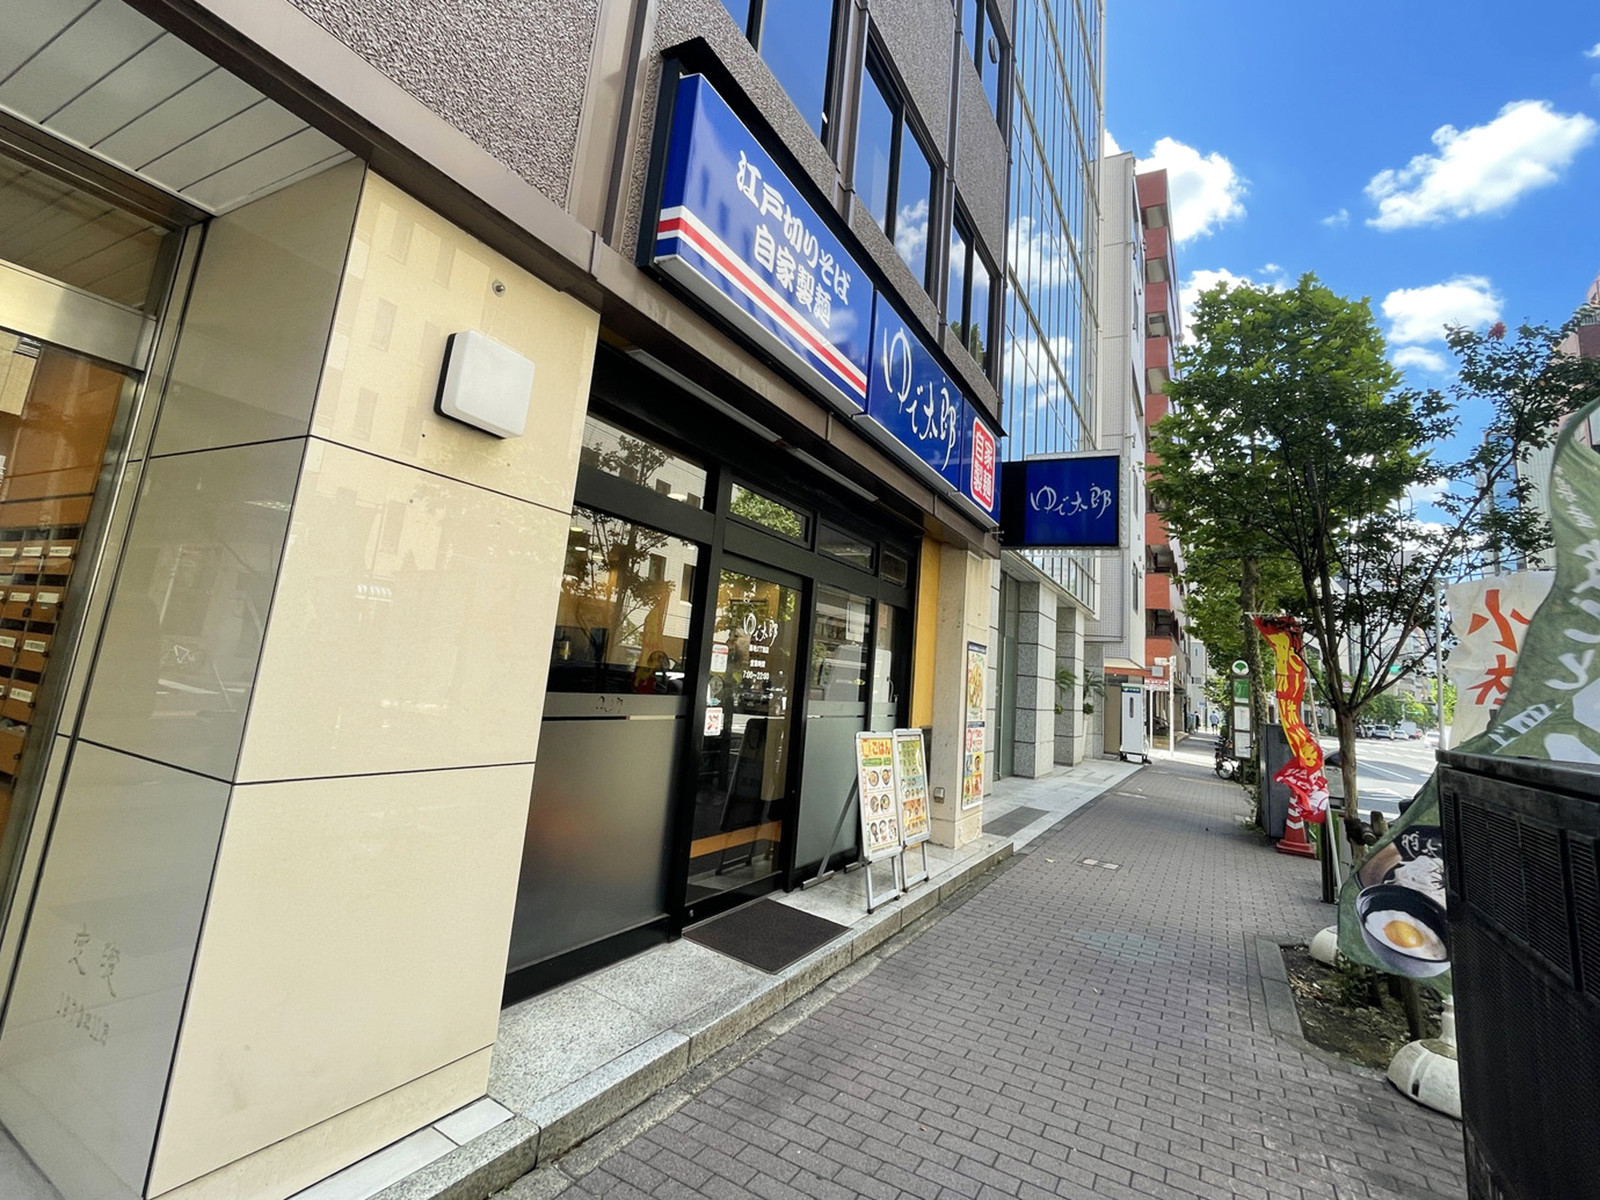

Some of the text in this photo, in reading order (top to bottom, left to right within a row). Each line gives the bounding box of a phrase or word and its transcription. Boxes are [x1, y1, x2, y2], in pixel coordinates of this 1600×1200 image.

[736, 150, 851, 305] 江戸切りそば
[754, 224, 832, 329] 自家製麺
[883, 327, 957, 471] ゆで太郎
[1030, 482, 1112, 519] ゆで太郎
